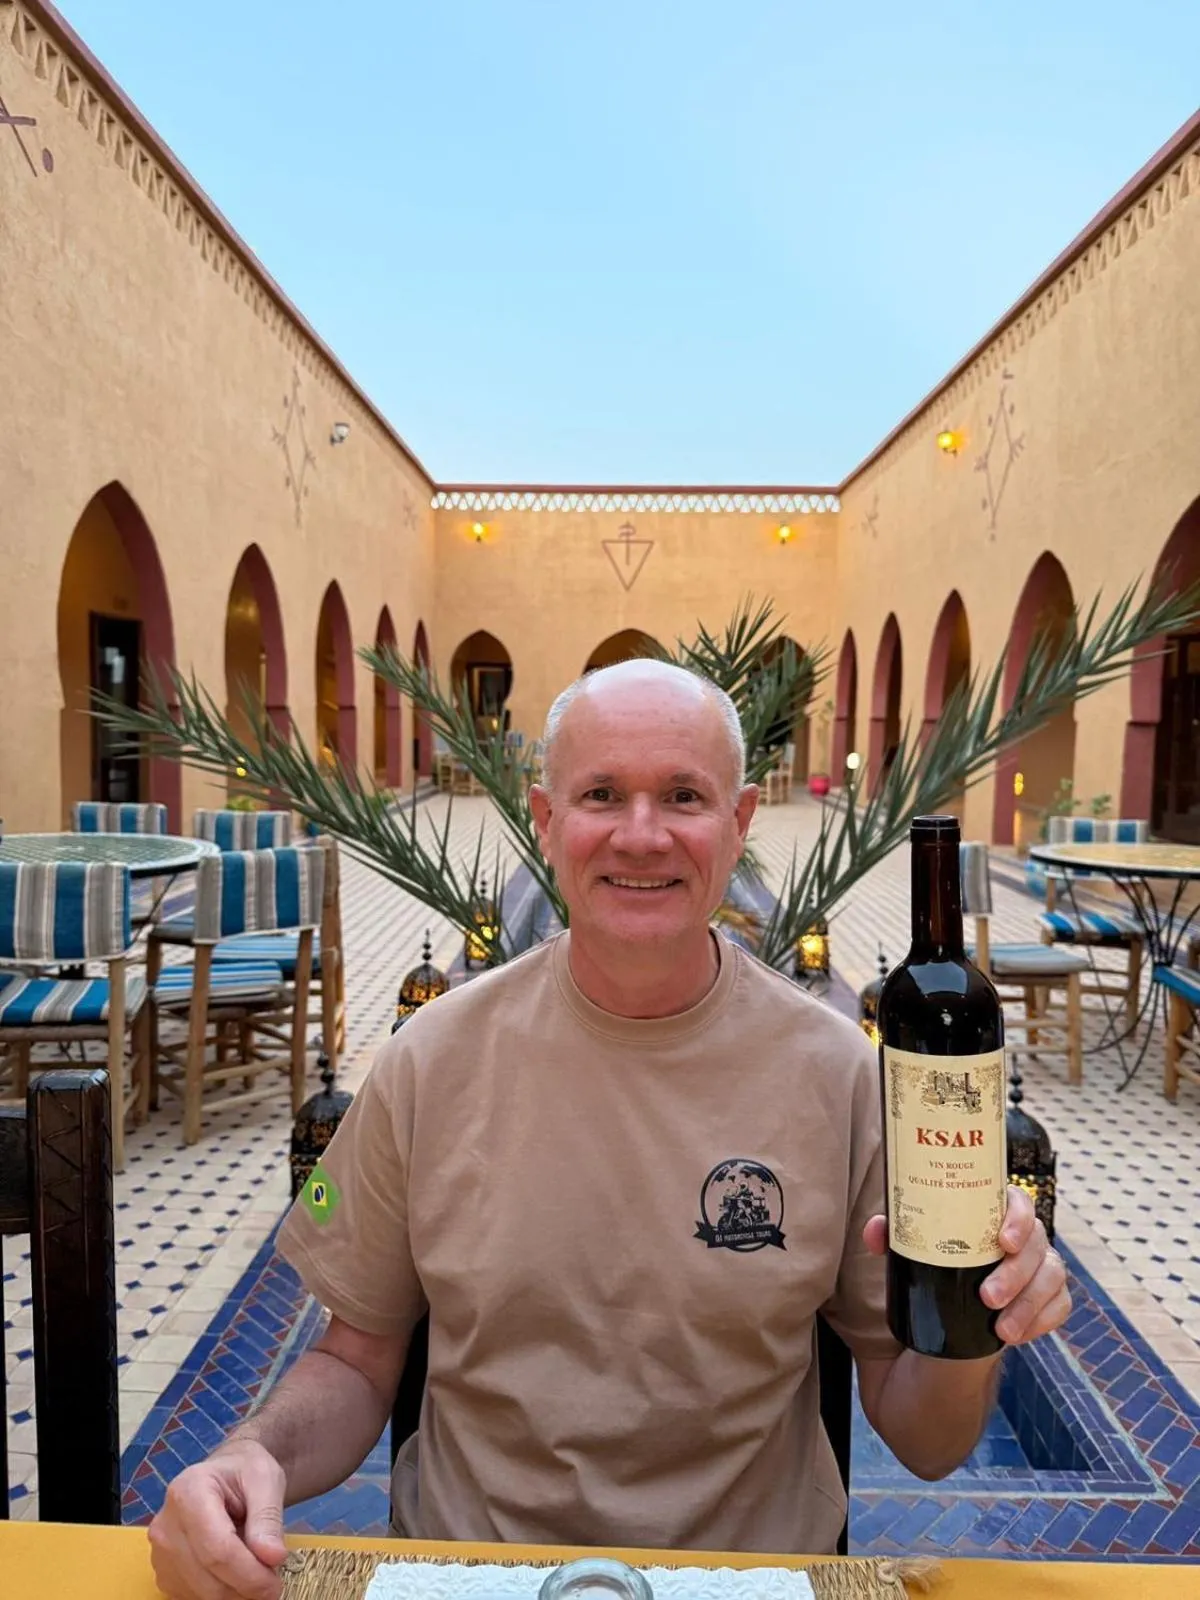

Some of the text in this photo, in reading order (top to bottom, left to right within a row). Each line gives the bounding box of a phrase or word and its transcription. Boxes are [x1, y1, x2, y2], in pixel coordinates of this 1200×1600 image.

[916, 1127, 984, 1148] KSAR
[929, 1160, 975, 1170] VIN ROUGE
[908, 1175, 944, 1188] QUALITÉ
